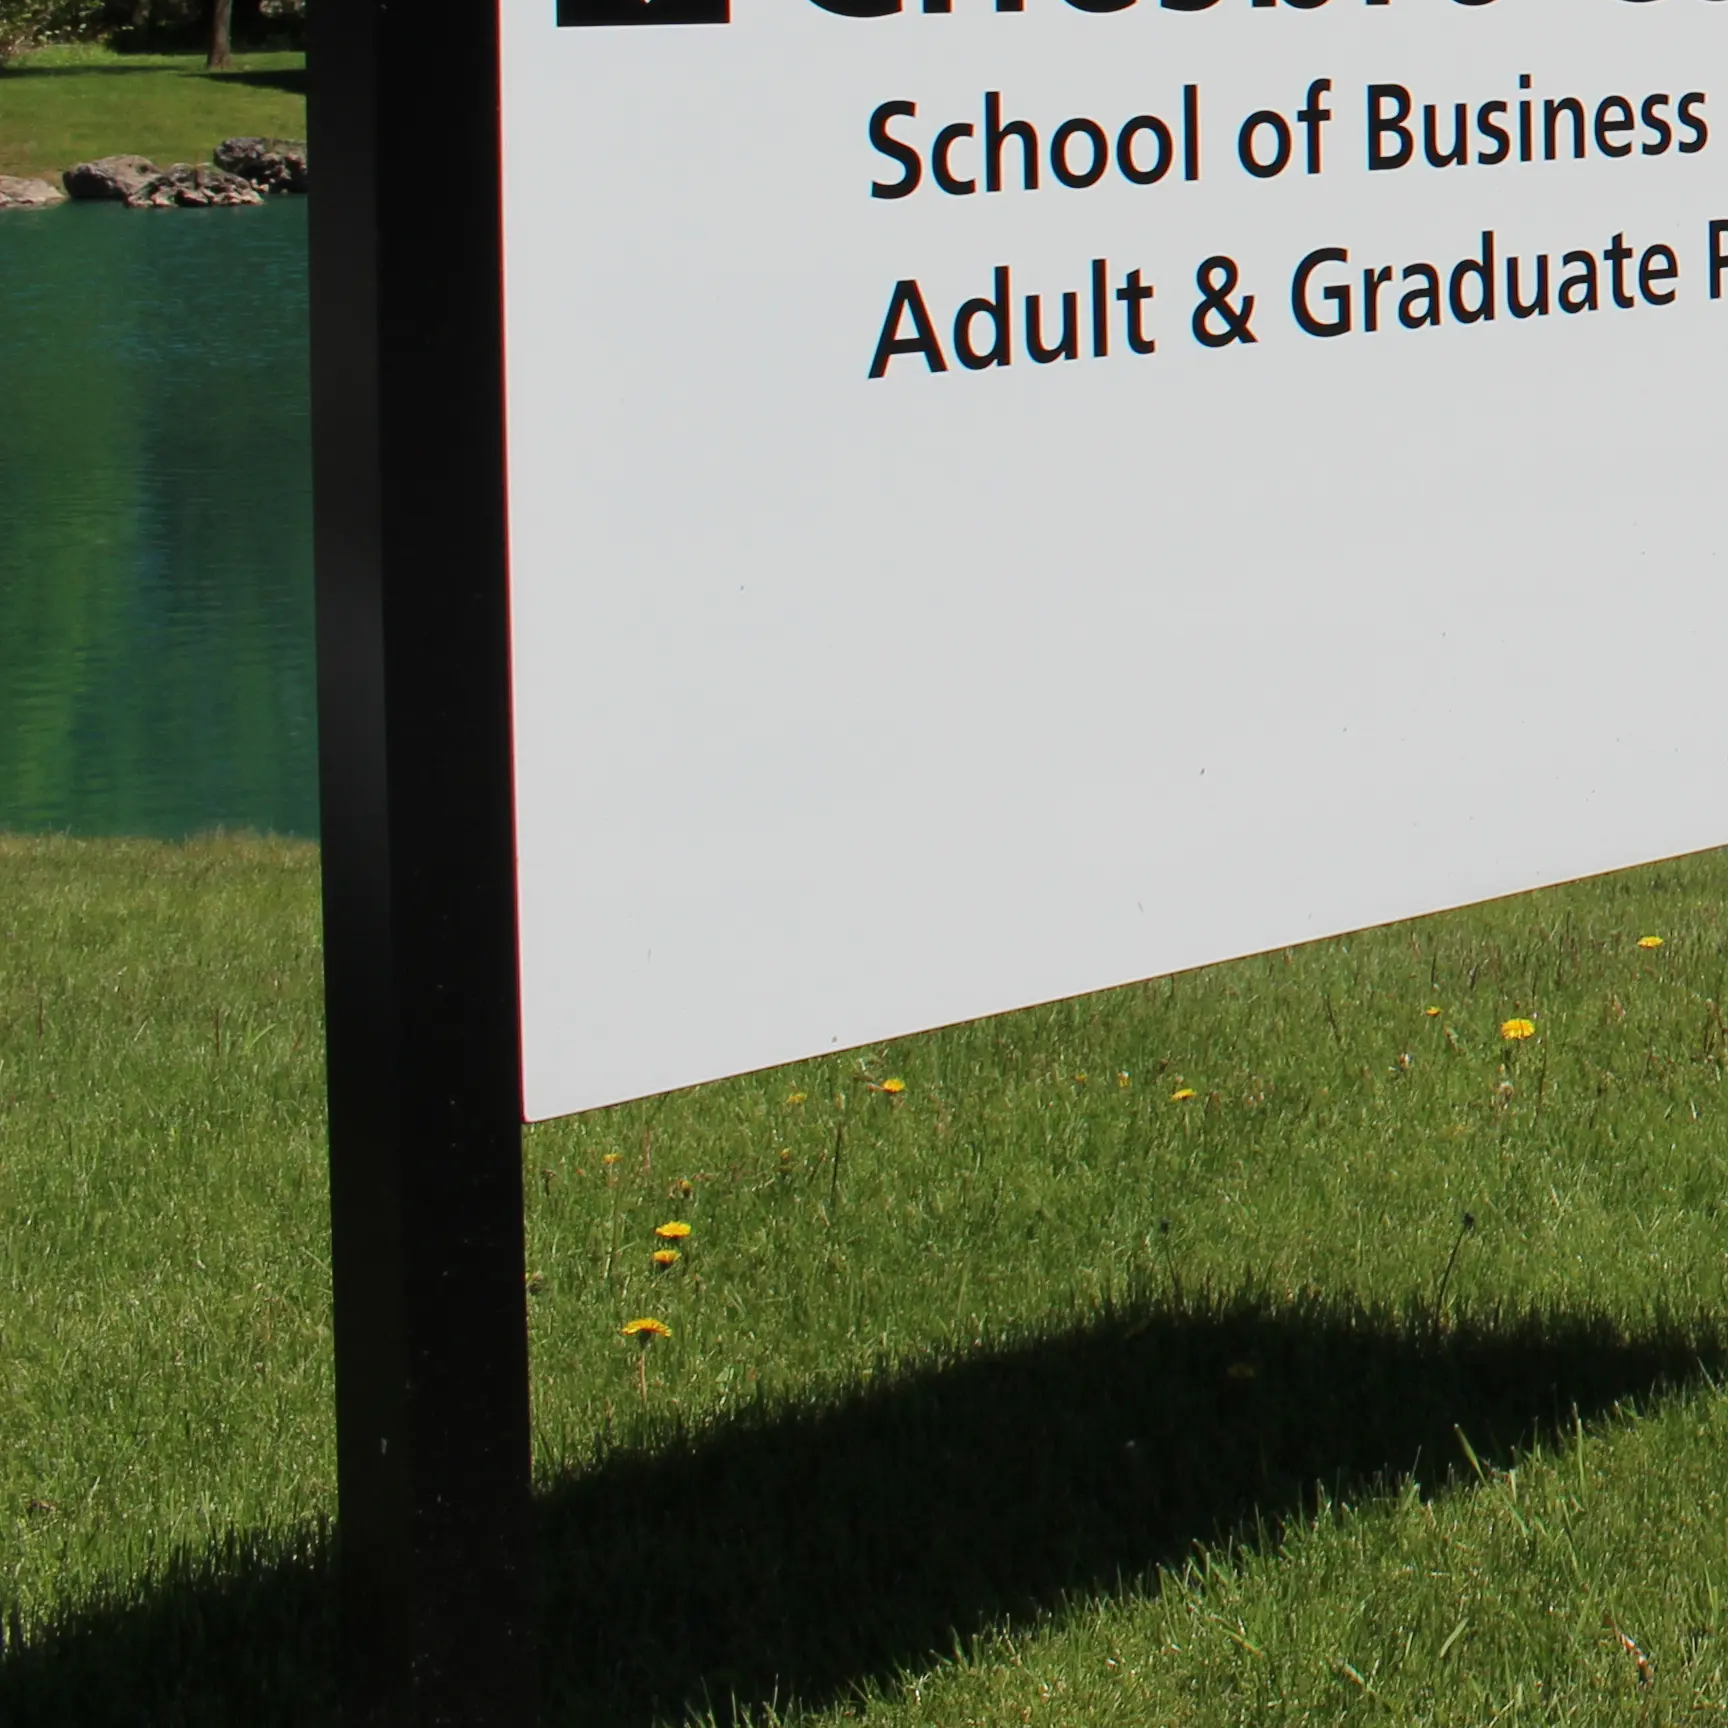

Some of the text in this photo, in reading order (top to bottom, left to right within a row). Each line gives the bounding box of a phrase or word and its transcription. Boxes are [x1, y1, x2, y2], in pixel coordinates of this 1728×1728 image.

[868, 76, 1710, 201] School of Business
[867, 257, 1156, 380] Adult
[1191, 254, 1258, 349] &
[1290, 229, 1679, 339] Graduate
